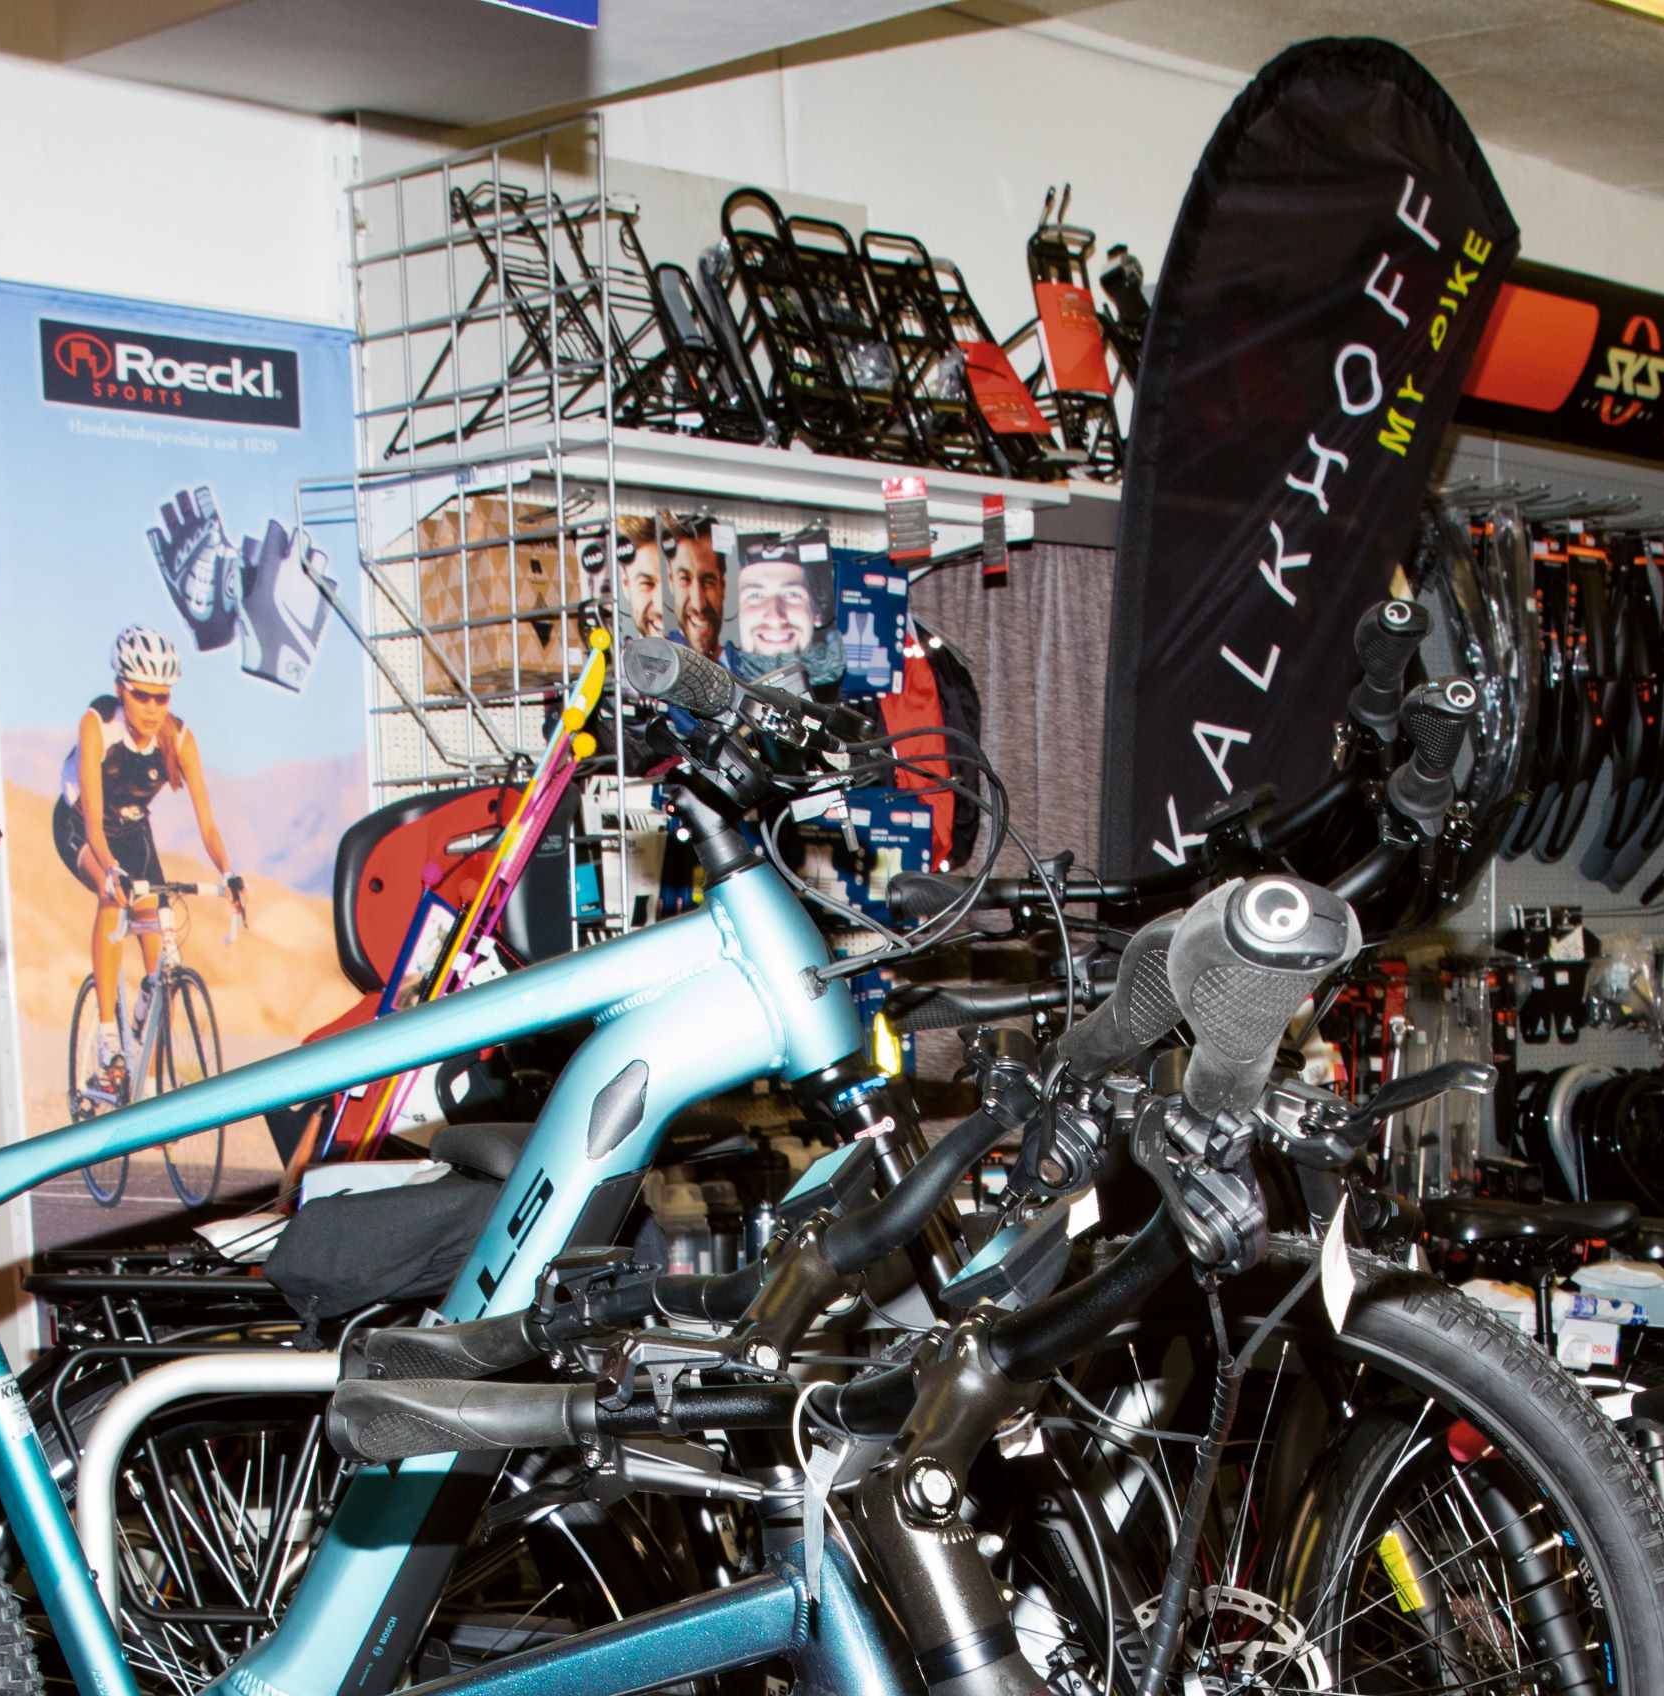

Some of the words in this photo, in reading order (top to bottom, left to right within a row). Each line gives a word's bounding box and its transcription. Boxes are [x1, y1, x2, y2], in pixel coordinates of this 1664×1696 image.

[91, 382, 183, 407] SPORTS
[1377, 374, 1427, 458] MY
[214, 433, 238, 451] seit
[243, 437, 279, 455] 1839
[1152, 175, 1440, 868] KALKHOFF
[1592, 1344, 1612, 1355] OSCH
[377, 1614, 400, 1647] BOSCH
